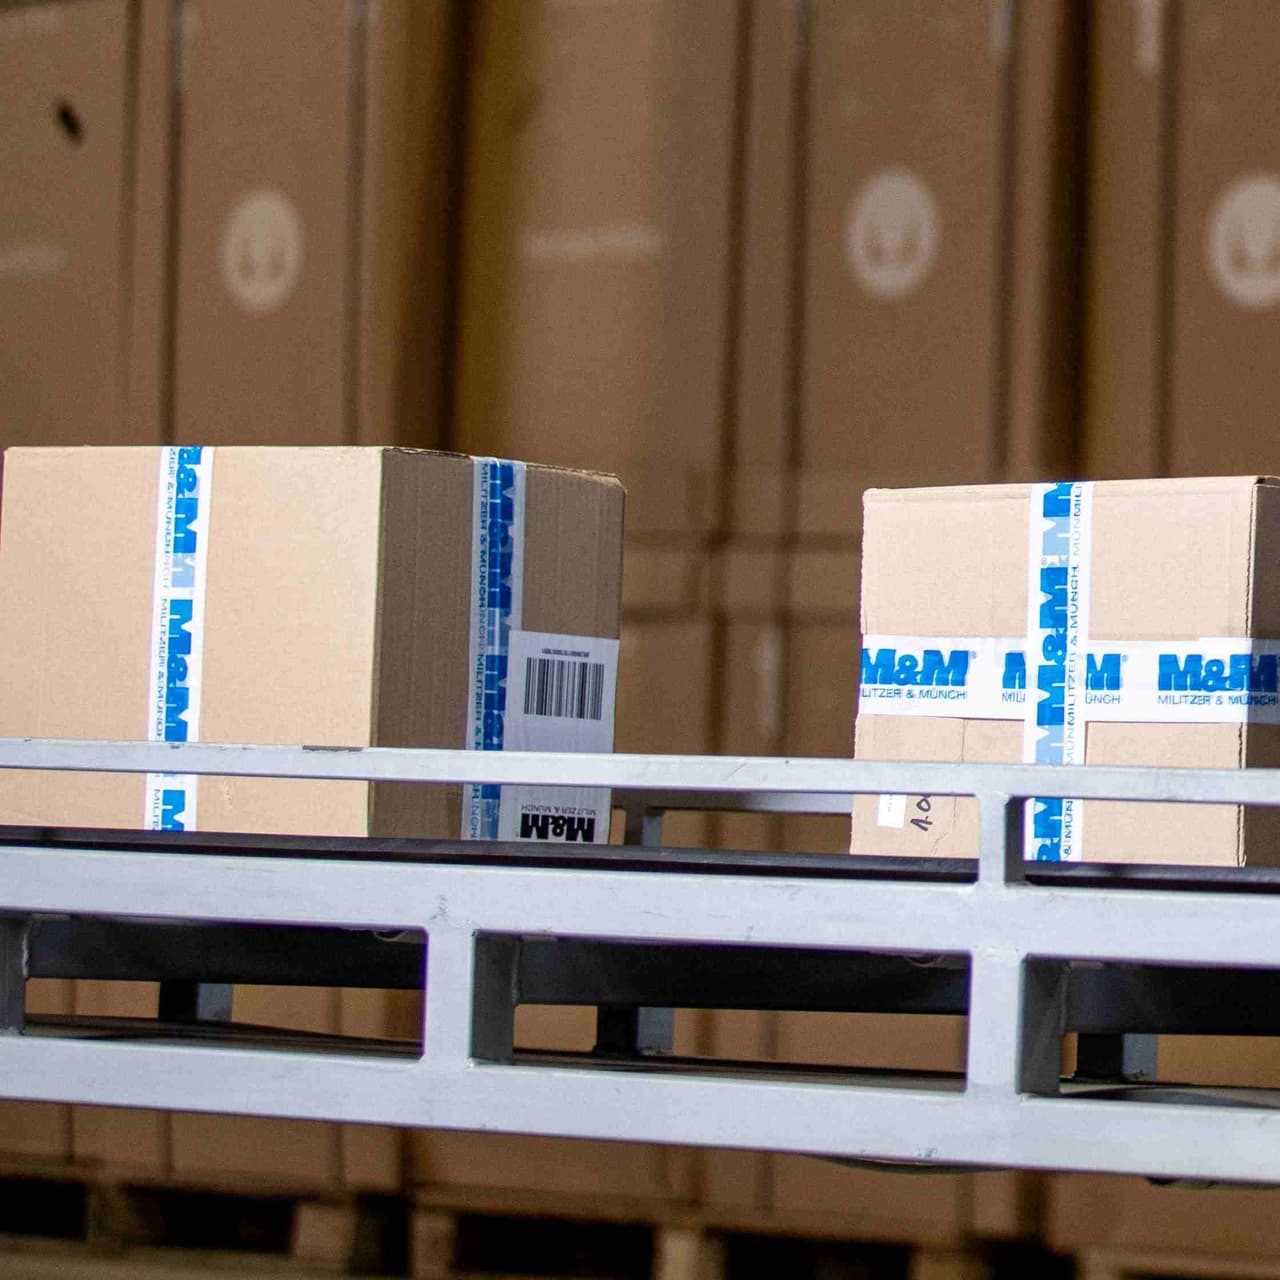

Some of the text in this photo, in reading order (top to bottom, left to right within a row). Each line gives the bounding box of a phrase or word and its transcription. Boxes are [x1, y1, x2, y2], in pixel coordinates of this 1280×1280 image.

[488, 463, 515, 609] M&M
[165, 599, 193, 742] M&M
[861, 648, 969, 686] M&M
[1157, 653, 1278, 692] M&M
[1036, 566, 1070, 726] M&M
[861, 688, 902, 698] LITZER
[905, 689, 915, 699] &
[1067, 652, 1077, 726] MILITZER
[1157, 694, 1211, 705] MILITZER
[1215, 694, 1223, 705] &
[519, 813, 596, 843] M&M
